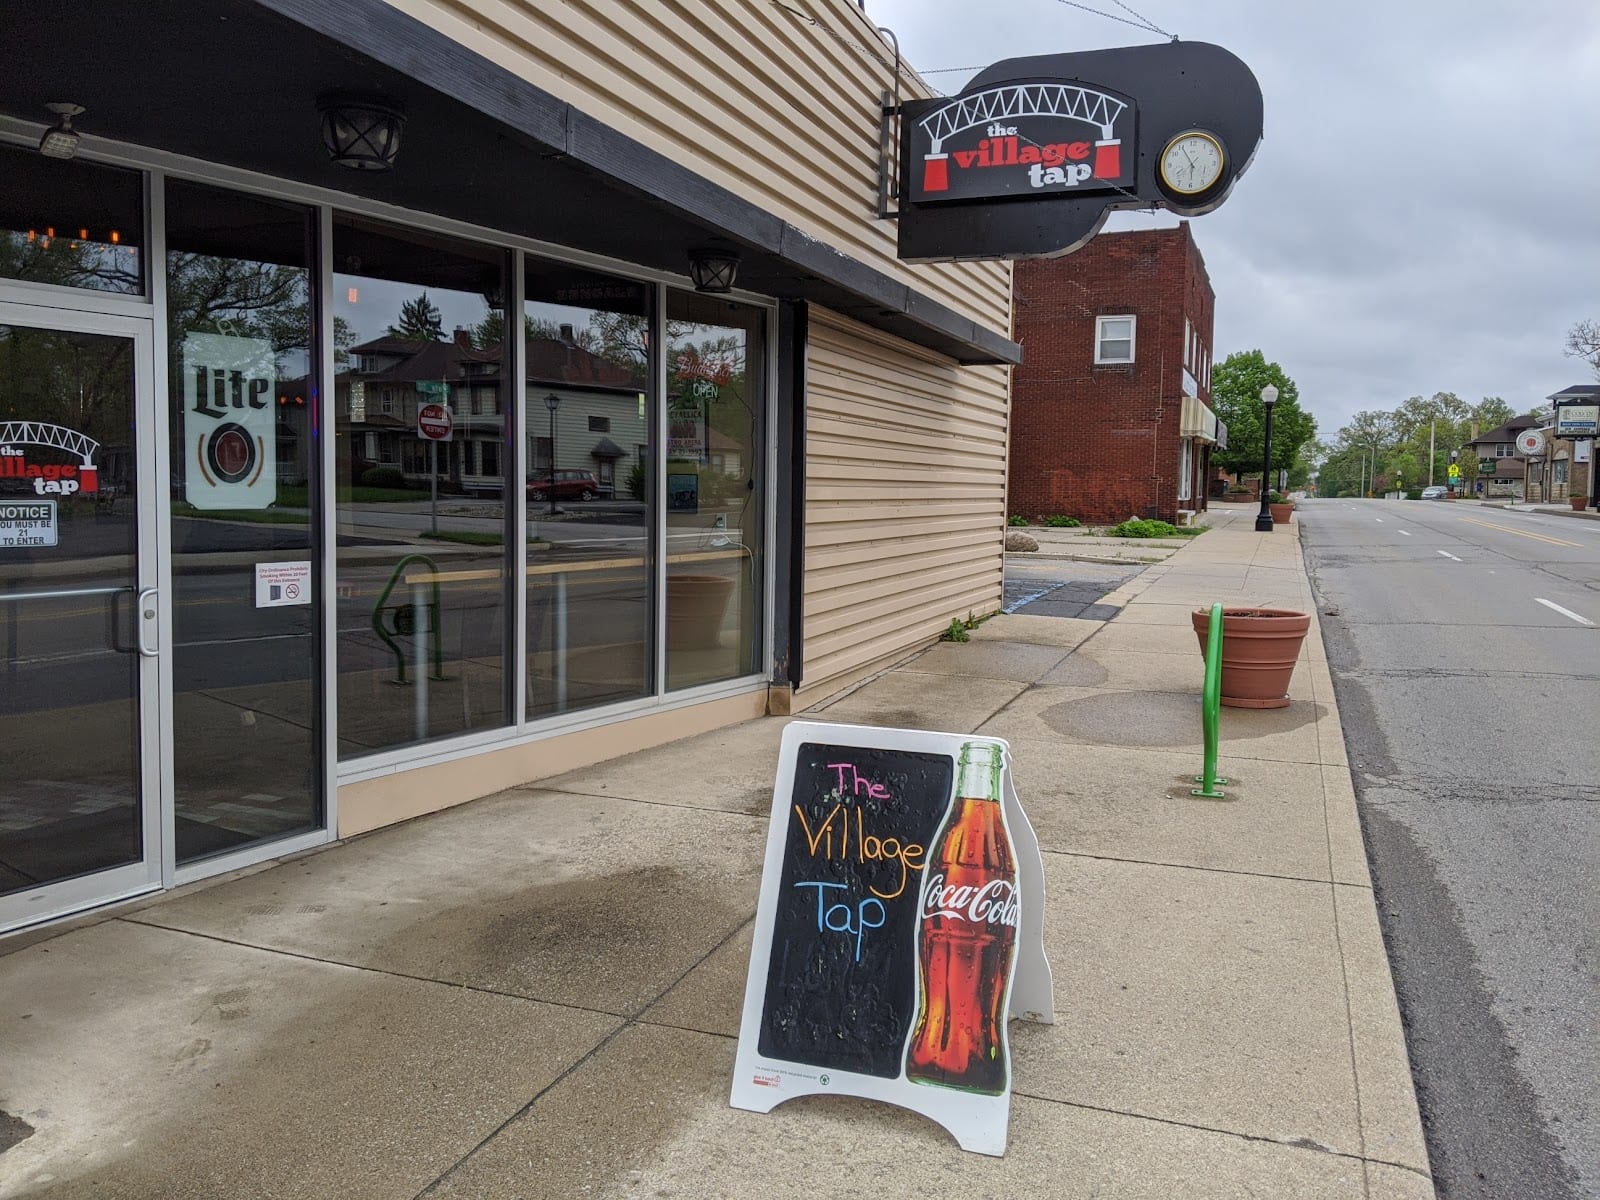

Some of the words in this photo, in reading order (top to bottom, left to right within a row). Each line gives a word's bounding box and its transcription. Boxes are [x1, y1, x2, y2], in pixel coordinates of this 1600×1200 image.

[986, 122, 1018, 137] the
[953, 136, 1090, 169] village
[1028, 162, 1092, 187] tap
[191, 364, 269, 419] Lite
[693, 383, 718, 398] OPEN
[0, 445, 25, 456] the
[33, 477, 79, 495] tap
[0, 506, 49, 519] NOTICE
[0, 520, 12, 529] OU
[15, 520, 38, 529] MUST
[41, 520, 52, 528] BE
[18, 529, 28, 537] 21
[3, 537, 14, 545] TO
[17, 536, 44, 545] ENTER
[827, 763, 891, 799] The
[794, 803, 926, 898] Village
[922, 873, 1018, 927] Coca-Cola
[793, 881, 886, 962] Tap
